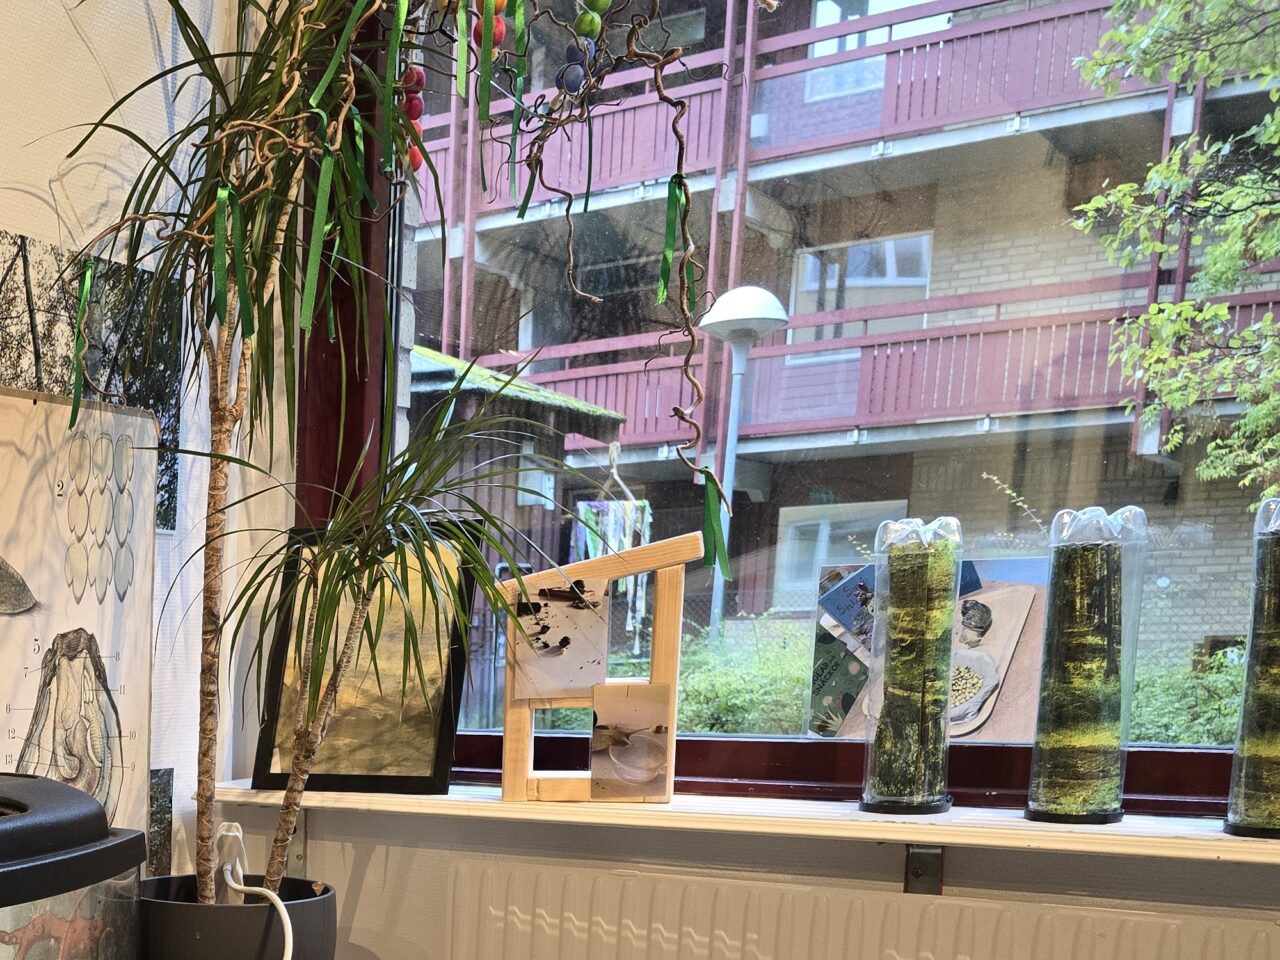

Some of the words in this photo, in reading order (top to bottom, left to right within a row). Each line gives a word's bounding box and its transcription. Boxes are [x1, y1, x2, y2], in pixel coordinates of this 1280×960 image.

[56, 480, 65, 498] 2
[33, 638, 40, 654] 5
[115, 651, 120, 662] 8
[6, 704, 11, 713] 6
[8, 728, 16, 739] 12
[129, 731, 136, 739] 10
